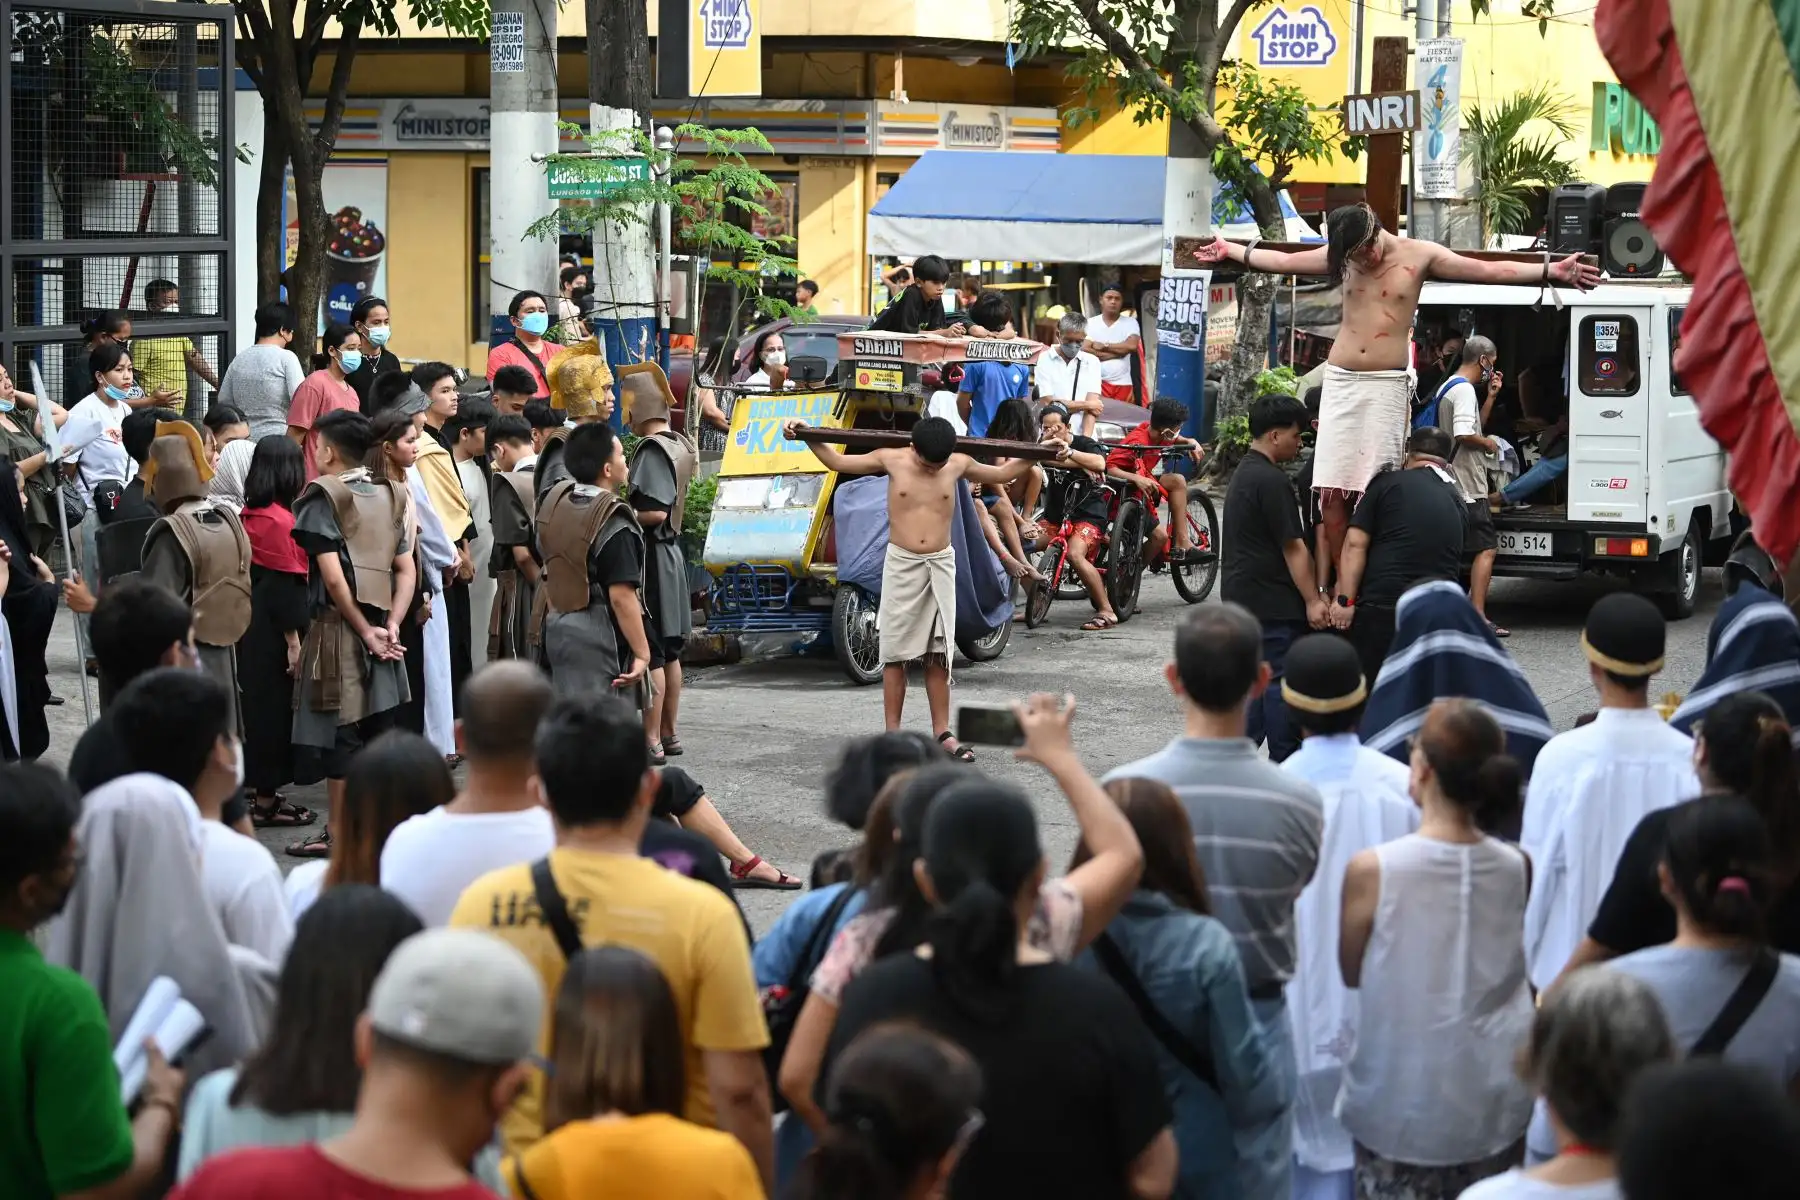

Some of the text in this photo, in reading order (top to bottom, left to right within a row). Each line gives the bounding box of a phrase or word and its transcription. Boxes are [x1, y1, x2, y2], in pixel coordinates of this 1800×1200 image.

[712, 0, 740, 17] MINI
[711, 19, 742, 39] STOP
[1271, 23, 1317, 40] MINI
[1267, 41, 1319, 59] STOP
[1347, 94, 1415, 132] INRI
[401, 118, 490, 136] MINISTOP
[952, 124, 1000, 142] MINISTOP
[628, 164, 644, 182] ST.
[1210, 315, 1237, 325] MOVEM
[1600, 325, 1619, 337] 3524
[854, 338, 904, 357] SARAH
[966, 341, 1009, 359] COTABATO
[1497, 535, 1547, 550] SO 514
